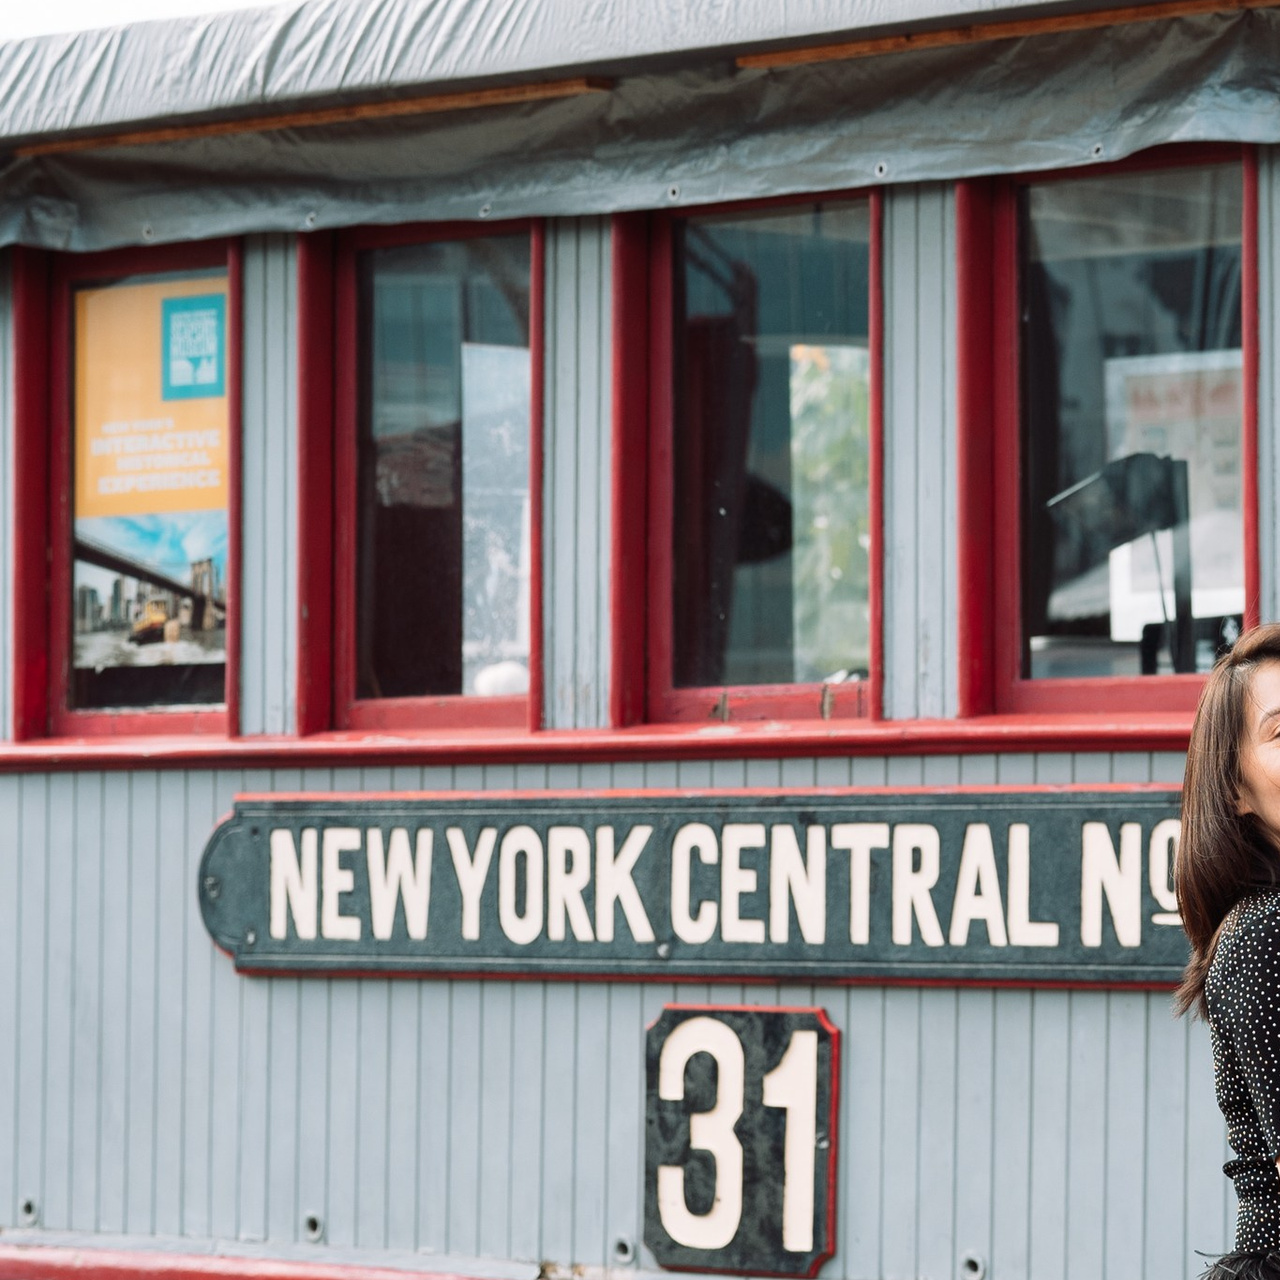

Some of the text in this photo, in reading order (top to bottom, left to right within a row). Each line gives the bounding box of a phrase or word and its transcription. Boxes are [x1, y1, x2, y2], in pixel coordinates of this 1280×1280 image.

[92, 430, 220, 455] INTERACTIVE
[116, 452, 210, 471] HISTORICAL
[98, 470, 220, 494] EXPERIENCE
[270, 827, 434, 941] NEW
[446, 825, 656, 945] YORK
[670, 822, 1060, 947] CENTRAL
[657, 1016, 818, 1253] 31
